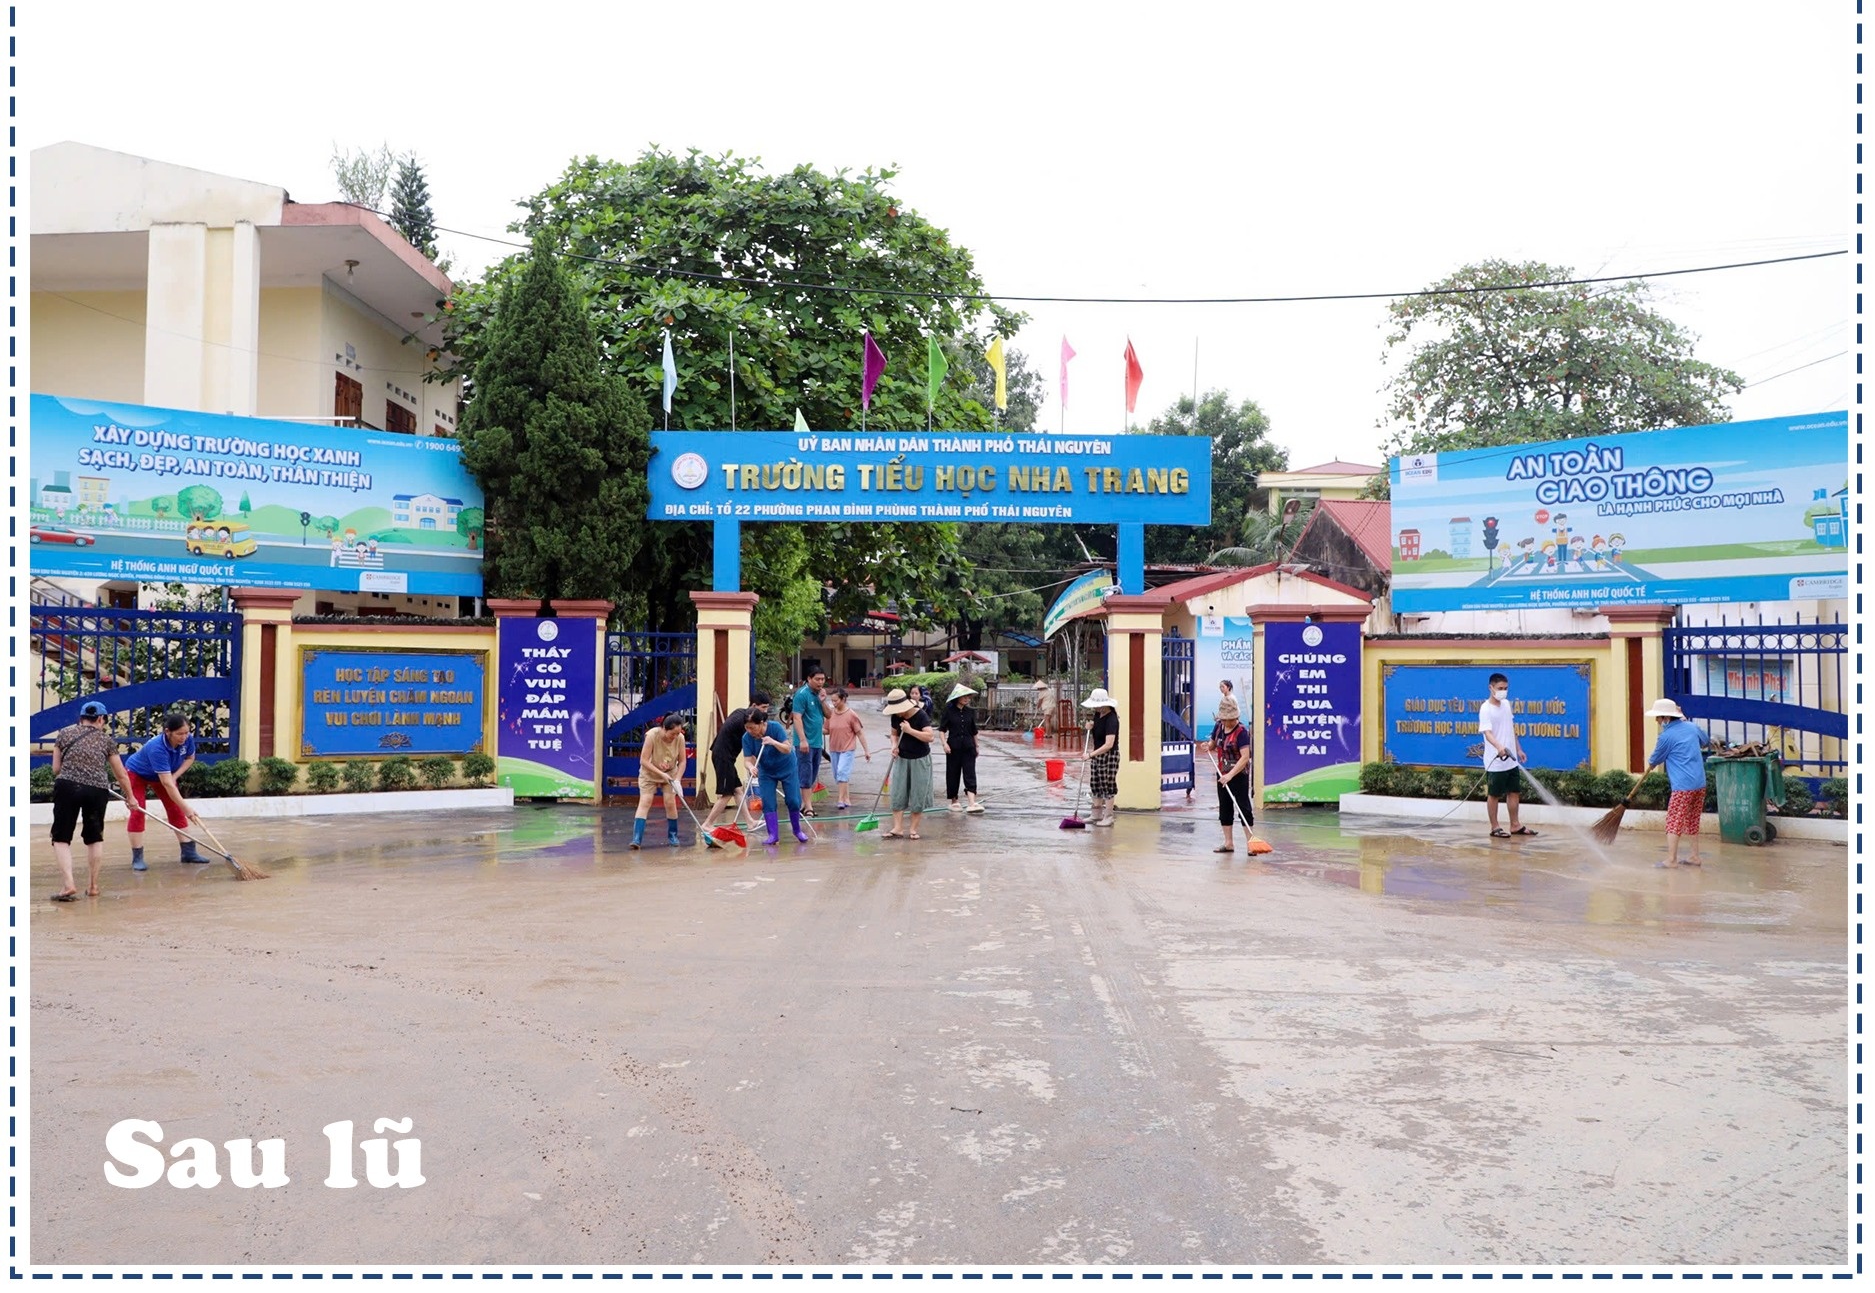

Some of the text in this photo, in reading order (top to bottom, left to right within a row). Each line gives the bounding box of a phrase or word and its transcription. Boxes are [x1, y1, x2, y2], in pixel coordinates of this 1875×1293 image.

[93, 424, 361, 468] XÂY DỰNG TRƯỜNG HỌC XANH
[425, 441, 444, 451] 1900
[822, 437, 851, 452] BAN
[855, 437, 896, 452] NHÂN
[898, 437, 929, 452] DÂN
[932, 437, 981, 453] THÀNH
[985, 435, 1011, 453] PHỐ
[1017, 437, 1051, 454] THÁI
[1055, 439, 1111, 455] NGUYÊN
[79, 448, 371, 492] SẠCH, ĐẸP, AN TOÀN, THÂN THIỆN
[1506, 443, 1624, 480] AN TOÀN
[722, 457, 845, 491] TRƯỜNG
[857, 453, 924, 491] TIỂU
[935, 465, 996, 497] HỌC
[1008, 466, 1072, 492] NHA
[1084, 466, 1189, 494] TRANG
[1536, 465, 1714, 505] GIAO THÔNG
[665, 504, 685, 517] ĐỊA
[715, 499, 732, 515] TỔ
[735, 505, 750, 515] 22
[754, 501, 803, 516] PHƯỜNG
[806, 505, 840, 516] PHAN
[843, 502, 874, 516] ĐÌNH
[878, 502, 918, 516] PHÙNG
[921, 502, 961, 517] THÀNH
[964, 501, 989, 517] PHỐ
[992, 504, 1019, 518] THÁI
[1023, 504, 1072, 518] NGUYÊN
[1597, 488, 1785, 517] LÀ HẠNH PHÚC CHO MỌI NHÀ
[111, 558, 236, 577] HỆ THỐNG ANH NGỮ QUỐC TẾ
[1531, 584, 1647, 602] HỆ THỐNG ANH NGỮ QUỐC TẾ
[1278, 652, 1346, 663] CHÚNG
[335, 666, 455, 686] HỌC TẬP SÁNG TẠO
[536, 662, 562, 673] CÔ
[1299, 670, 1326, 679] EM
[525, 679, 566, 688] VUN
[1296, 685, 1327, 694] THI
[313, 687, 473, 706] RÈN LUYỆN CHĂM NGOAN
[1292, 700, 1333, 709] ĐUA
[1404, 696, 1426, 712] GIÁO
[1428, 699, 1446, 715] DỤC
[325, 709, 461, 728] VUI CHƠI LÀNH MẠNH
[1282, 714, 1341, 726] LUYỆN
[1396, 716, 1432, 734] TRƯỜNG
[1434, 720, 1453, 736] HỌC
[1563, 724, 1579, 738] LAI
[533, 723, 563, 734] TRÍ
[1292, 728, 1332, 739] ĐỨC
[528, 738, 563, 751] TUỆ
[1296, 744, 1326, 754] TÀI
